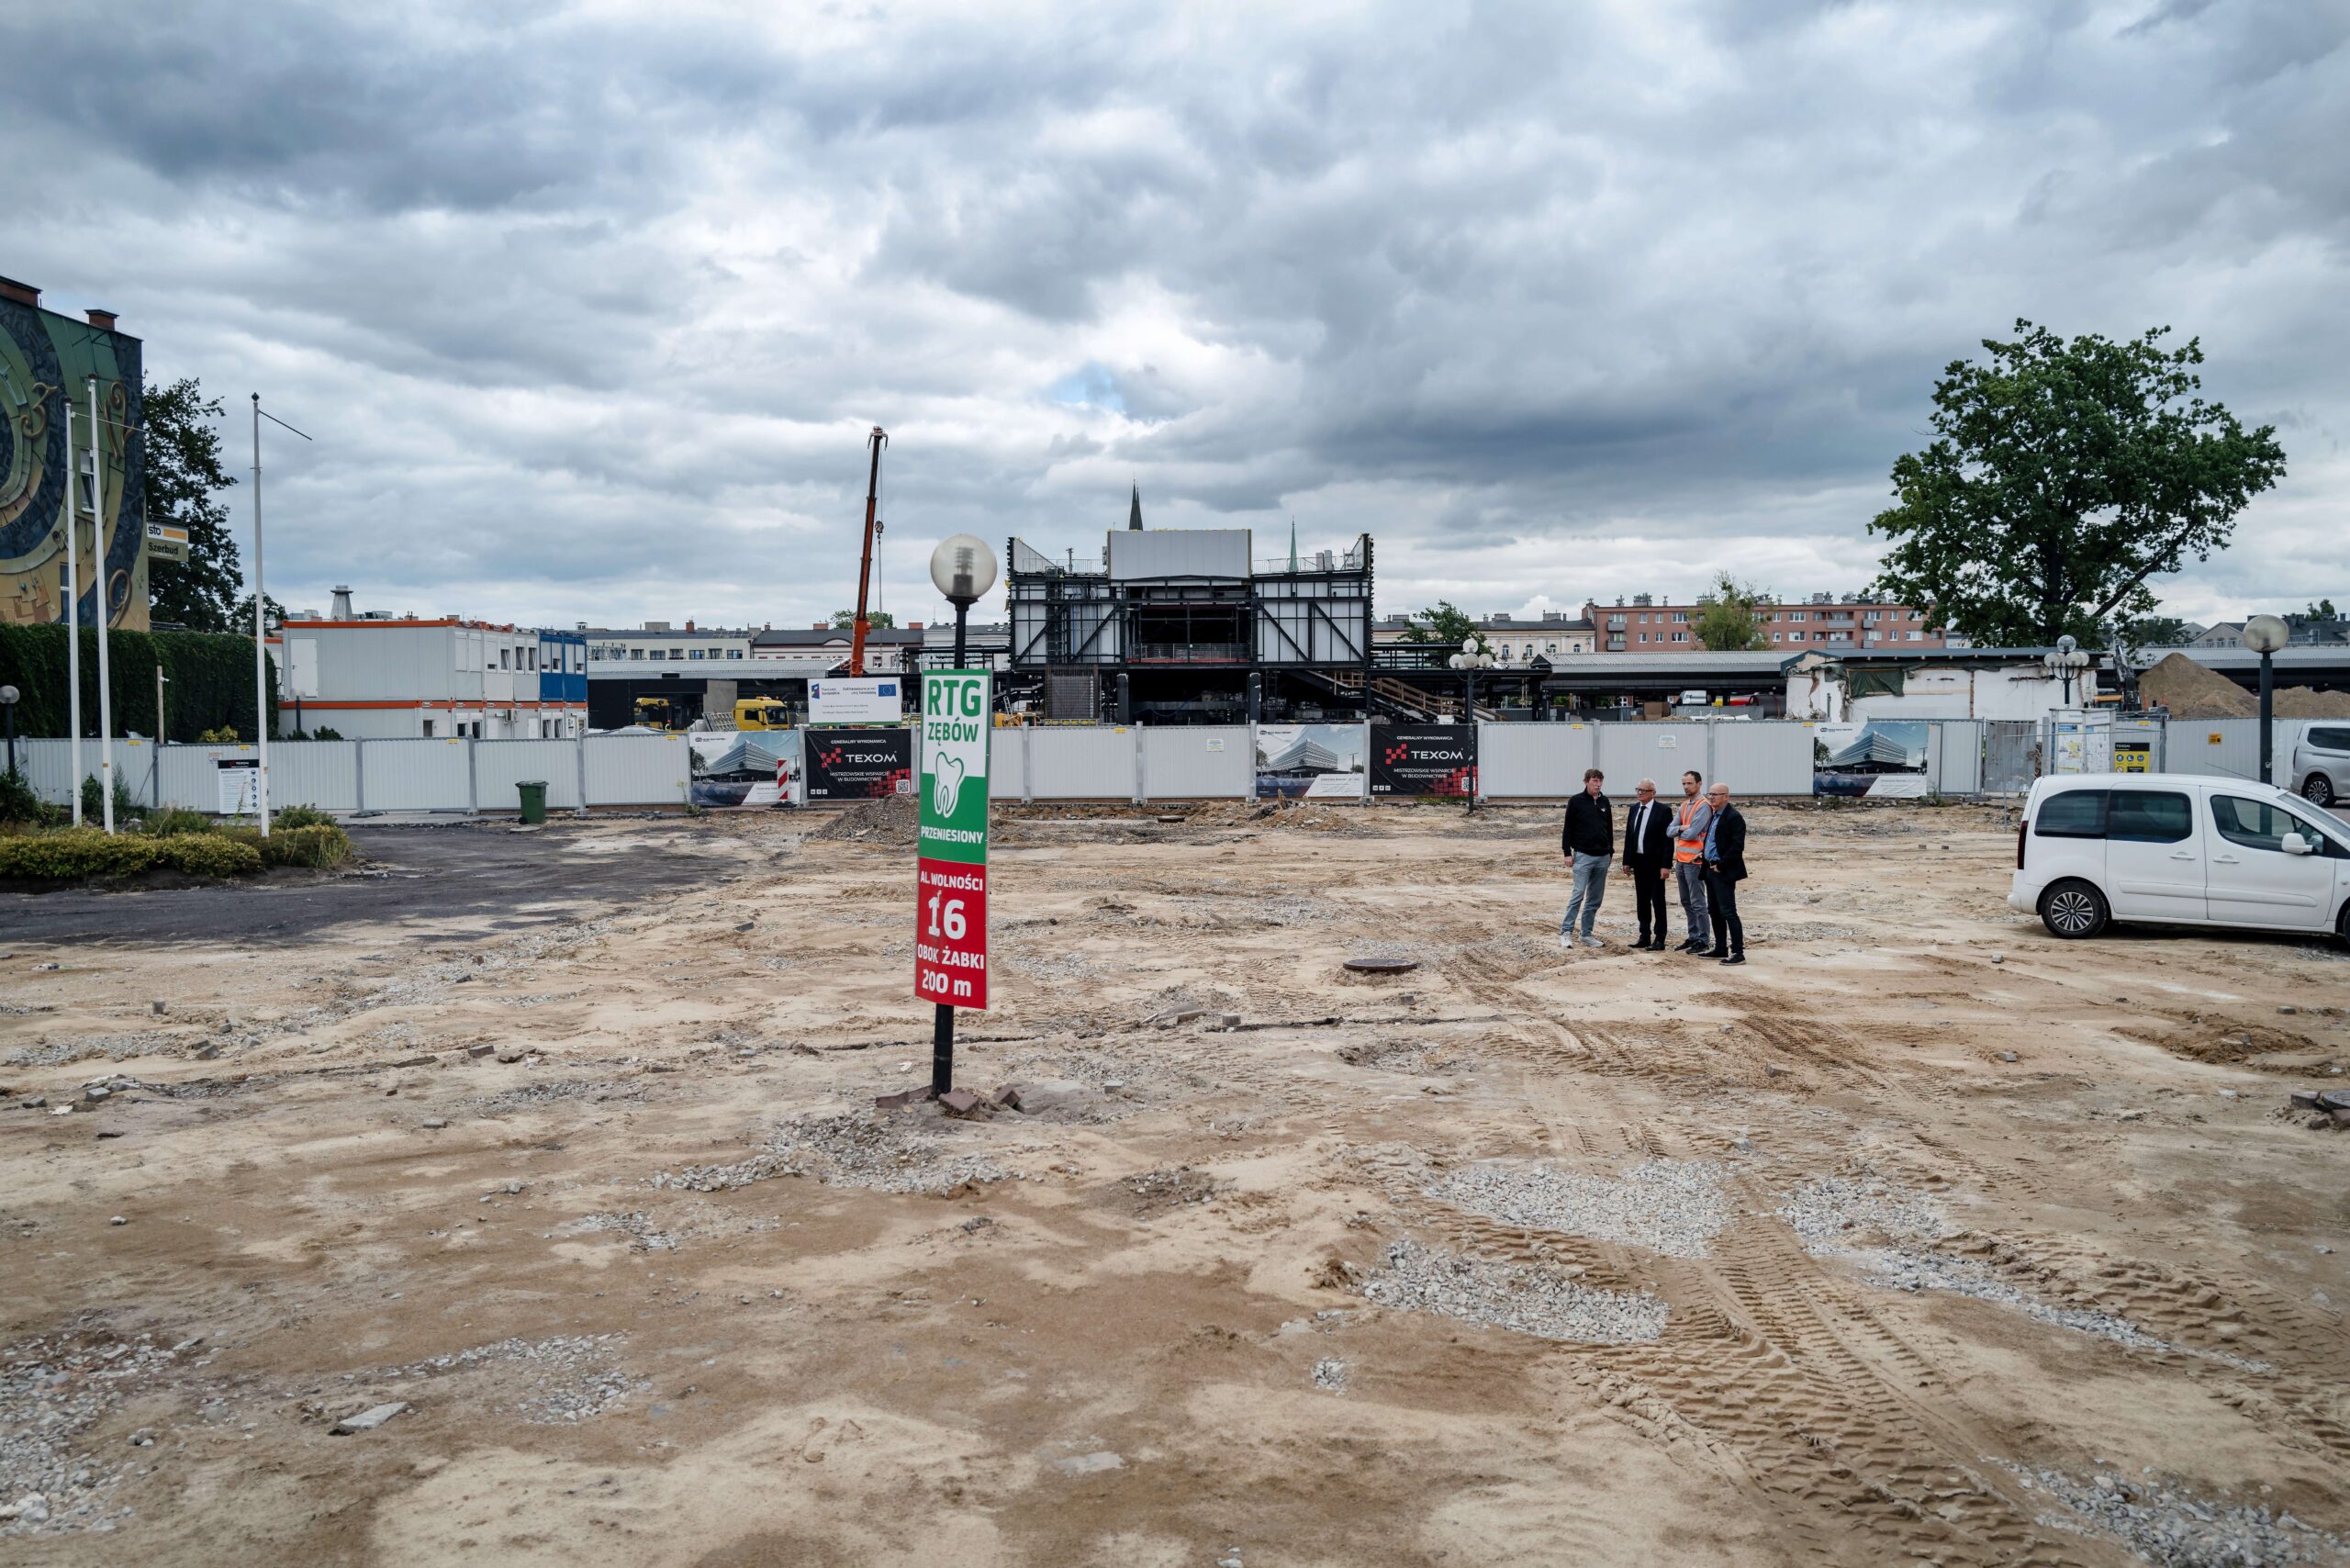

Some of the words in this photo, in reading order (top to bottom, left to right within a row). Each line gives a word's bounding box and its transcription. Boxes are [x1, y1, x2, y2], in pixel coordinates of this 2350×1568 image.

[148, 524, 162, 536] sto
[148, 542, 179, 554] Szerbud
[927, 679, 981, 717] RTG
[927, 716, 979, 746] ZĘBÓW
[845, 754, 898, 763] TEXOM
[1410, 751, 1463, 760] TEXOM
[921, 825, 984, 845] PRZENIESIONY
[931, 873, 983, 891] WOLNOŚCI
[928, 896, 967, 940] 16
[917, 943, 939, 964] OBOK
[941, 945, 985, 969] ŻABKI
[922, 969, 949, 993] 200
[953, 979, 971, 997] m
